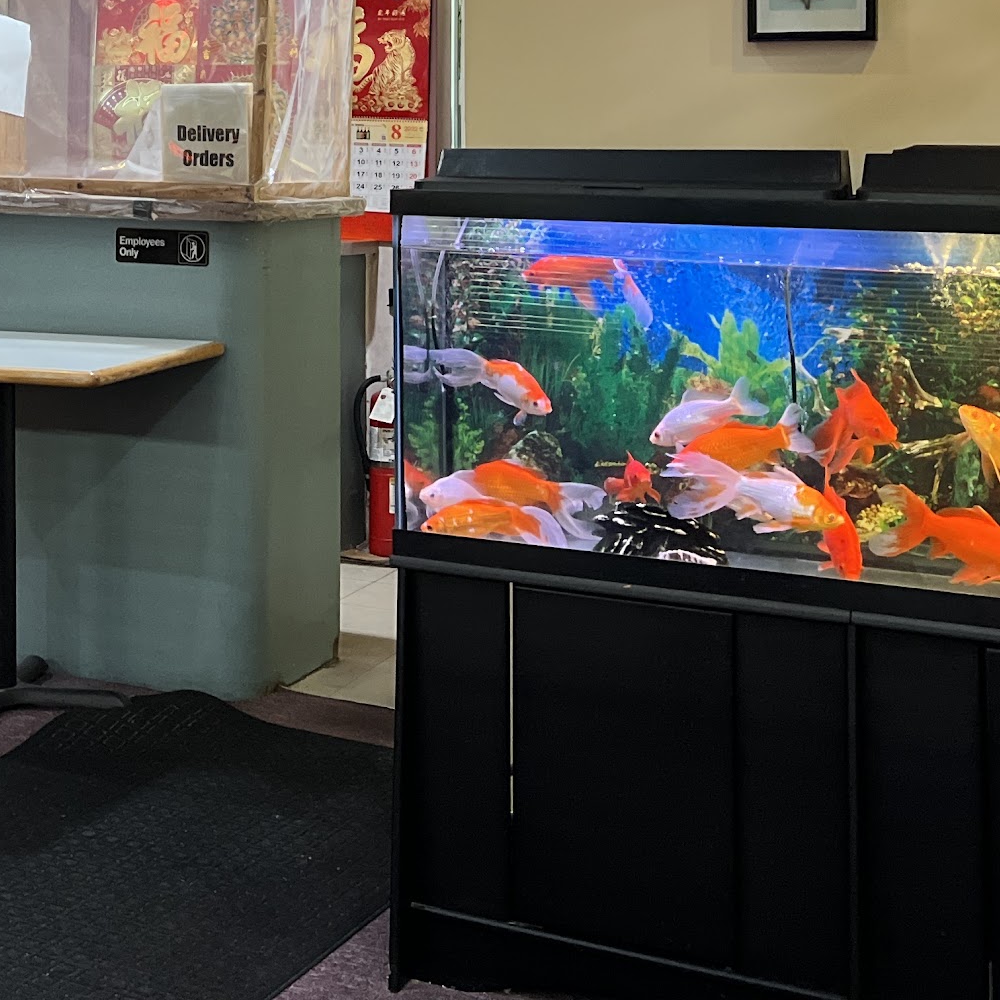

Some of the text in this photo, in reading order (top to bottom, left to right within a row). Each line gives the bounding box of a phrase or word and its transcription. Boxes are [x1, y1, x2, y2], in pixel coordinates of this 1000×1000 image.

[177, 124, 240, 144] Delivery
[391, 124, 402, 140] 8
[182, 150, 235, 167] Orders
[119, 236, 165, 248] Employees
[119, 246, 139, 259] Only
